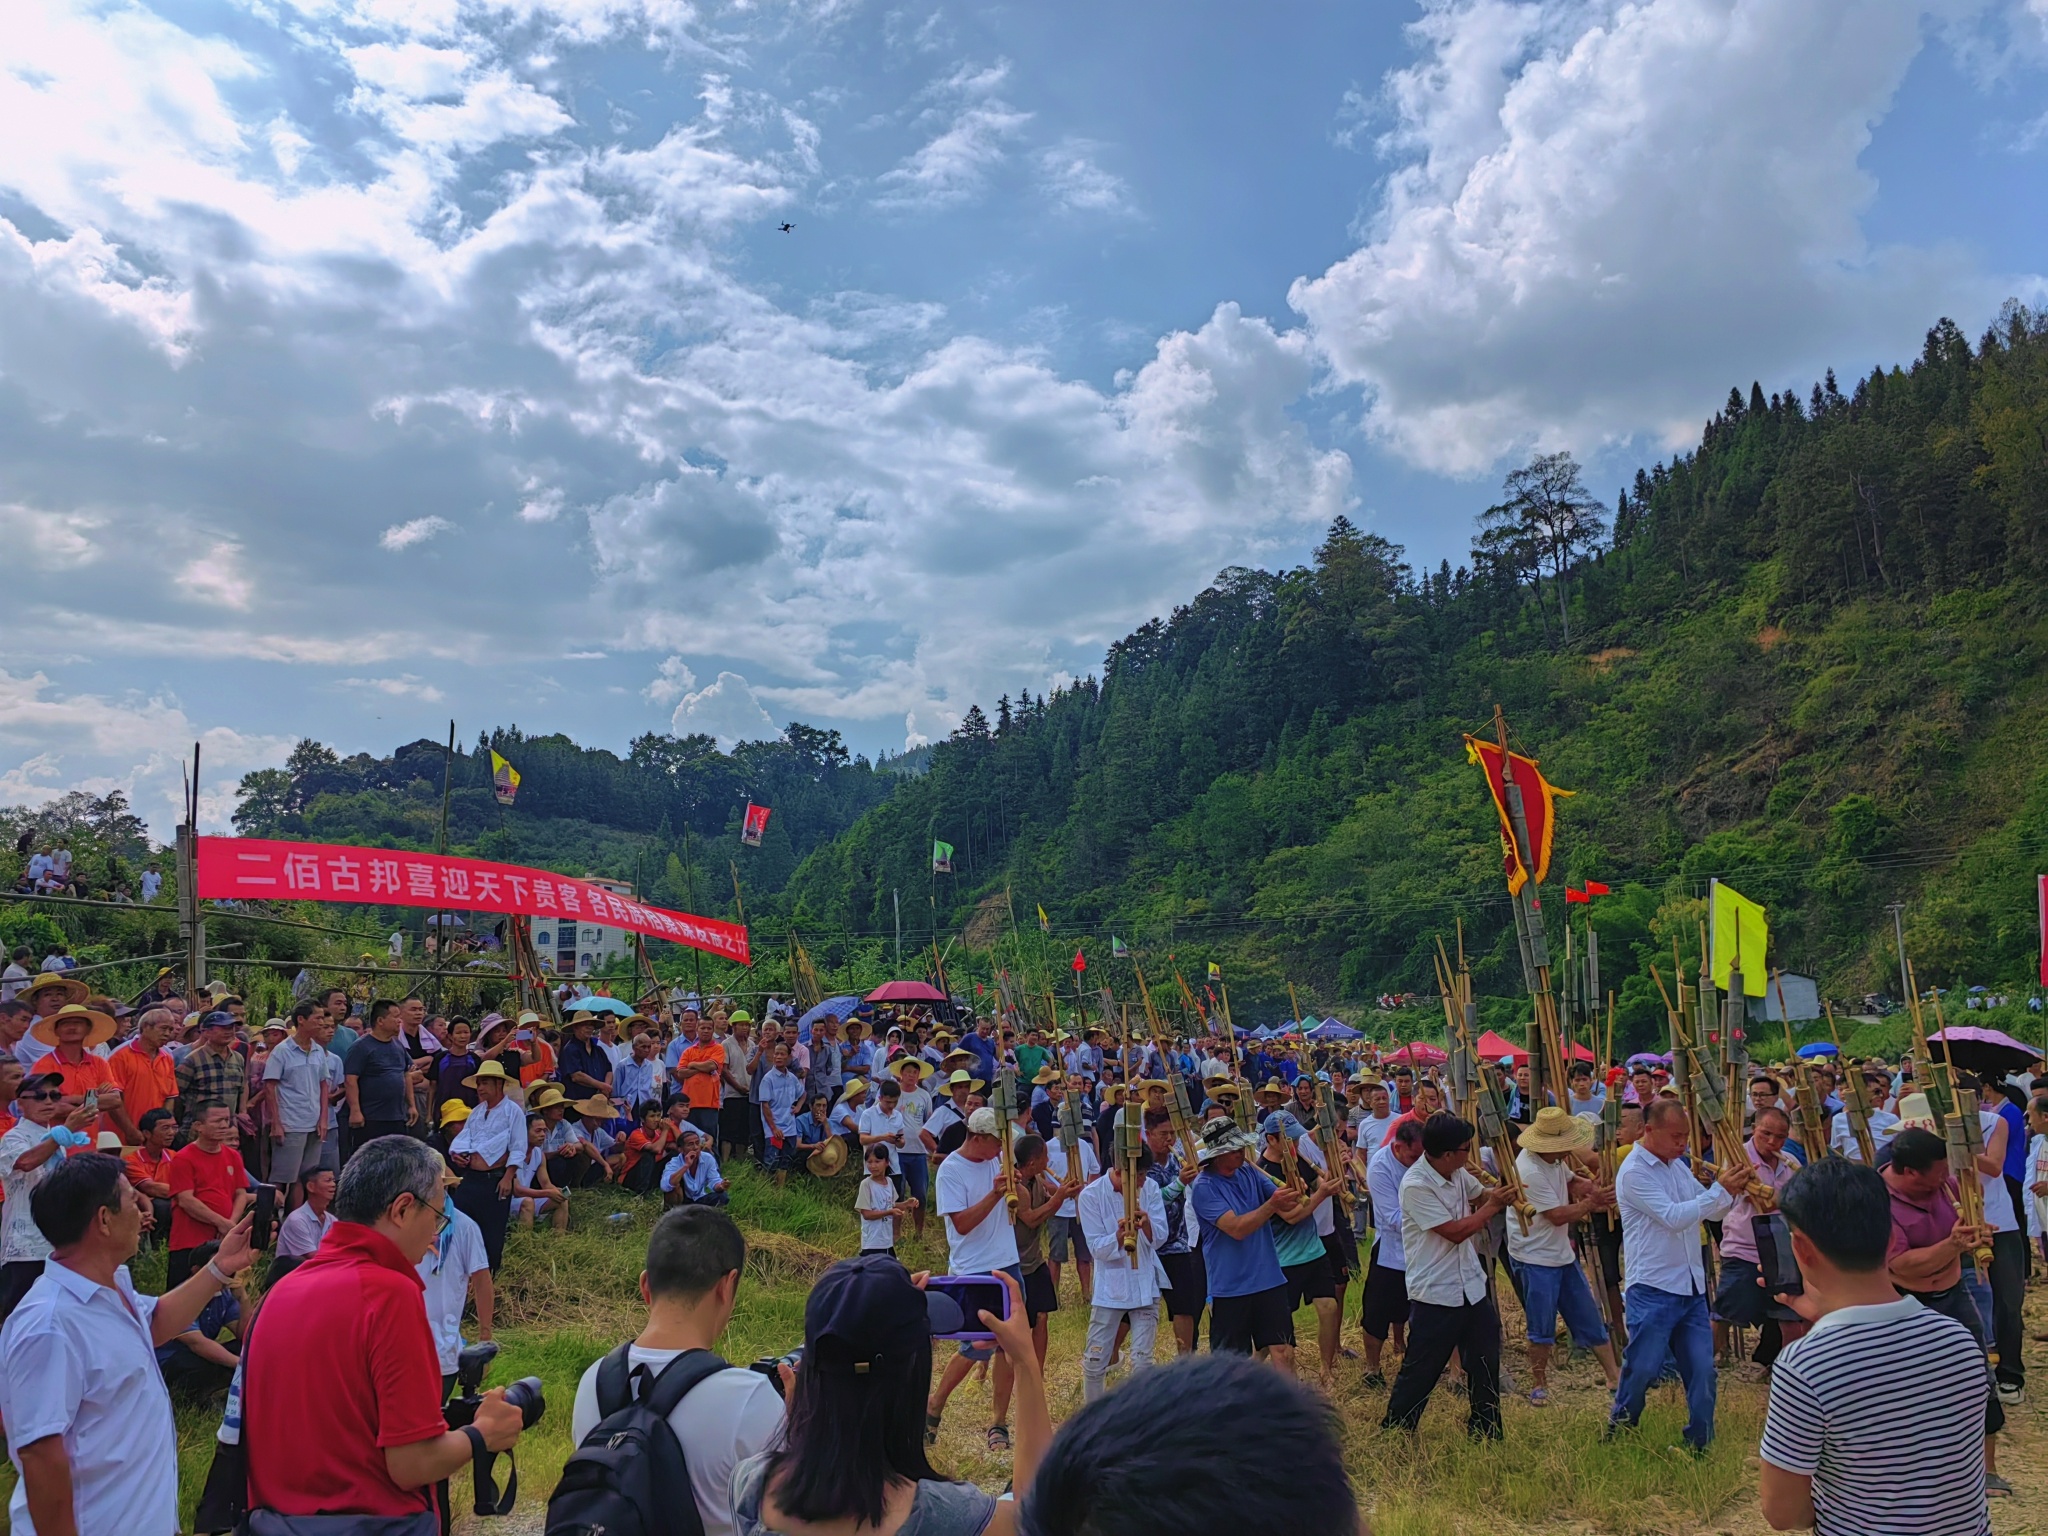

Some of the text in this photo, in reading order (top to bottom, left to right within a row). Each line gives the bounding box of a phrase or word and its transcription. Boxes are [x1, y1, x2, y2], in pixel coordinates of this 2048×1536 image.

[237, 852, 580, 913] 二佰古邦喜迎天下贵客
